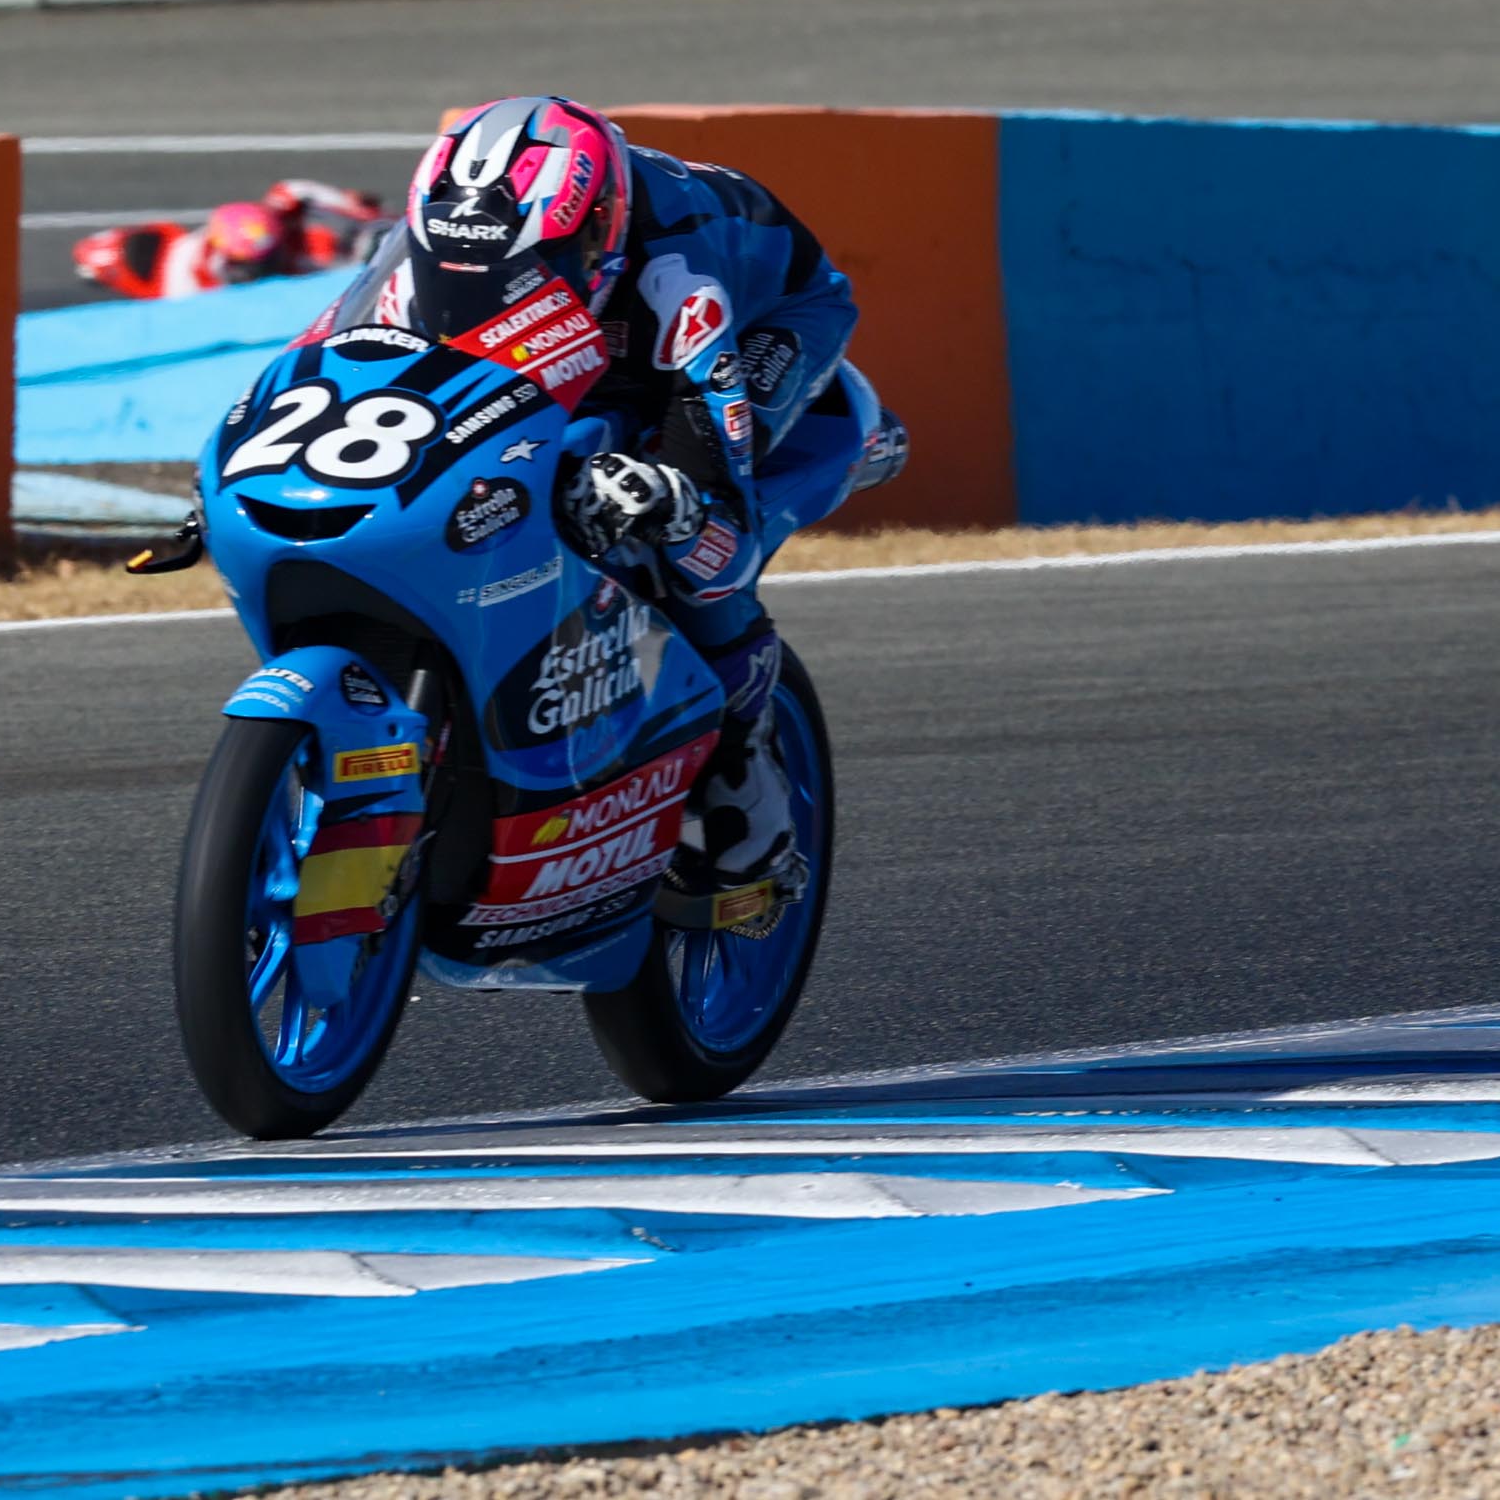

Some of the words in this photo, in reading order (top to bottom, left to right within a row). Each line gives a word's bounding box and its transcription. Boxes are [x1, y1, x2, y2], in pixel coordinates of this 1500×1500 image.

[426, 218, 509, 240] SHARK
[526, 313, 591, 355] MONLAU
[541, 345, 603, 389] MOTUL
[222, 385, 437, 480] 28
[445, 396, 518, 445] SAMSUNG
[530, 605, 649, 692] Estrella
[528, 655, 641, 735] Galicia
[566, 759, 684, 838] MONLAU
[521, 818, 660, 900] MOTUL
